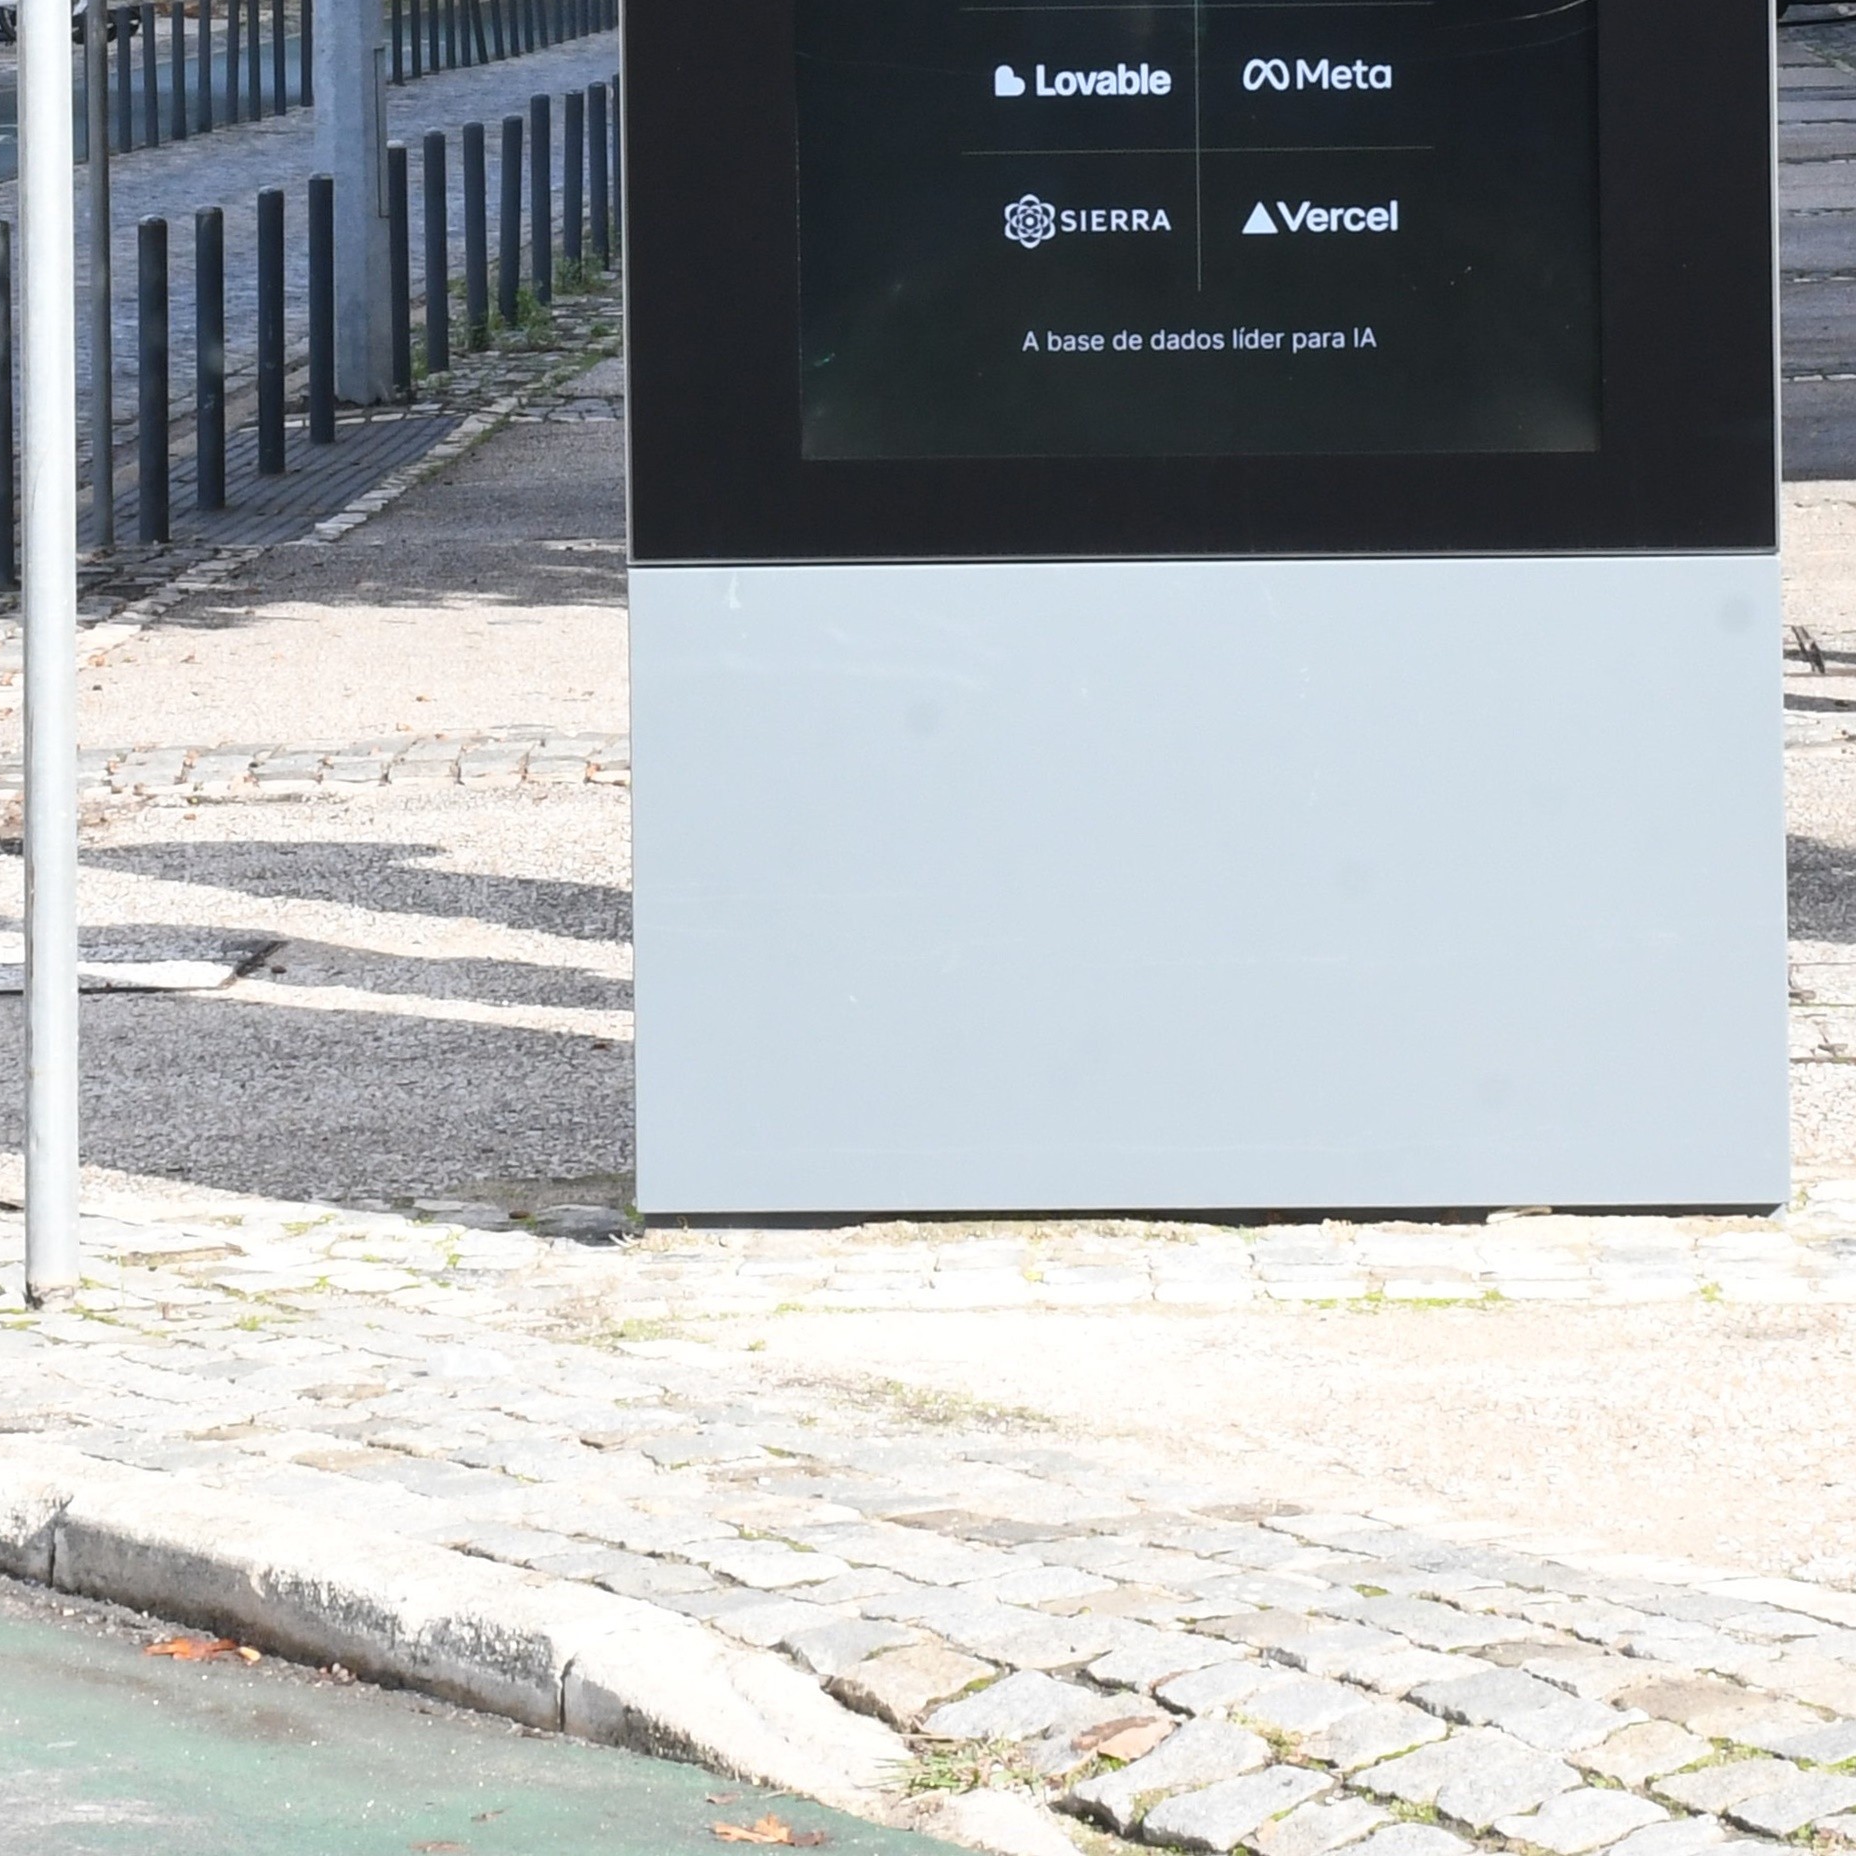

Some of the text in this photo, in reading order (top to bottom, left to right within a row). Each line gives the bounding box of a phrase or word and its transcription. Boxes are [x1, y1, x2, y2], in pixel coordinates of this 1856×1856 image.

[1035, 62, 1172, 97] Lovable
[1296, 58, 1393, 90] Meta
[1060, 209, 1172, 232] SIERRA
[1276, 200, 1398, 232] Vercel
[1022, 327, 1377, 354] A base de dados líder para IA
